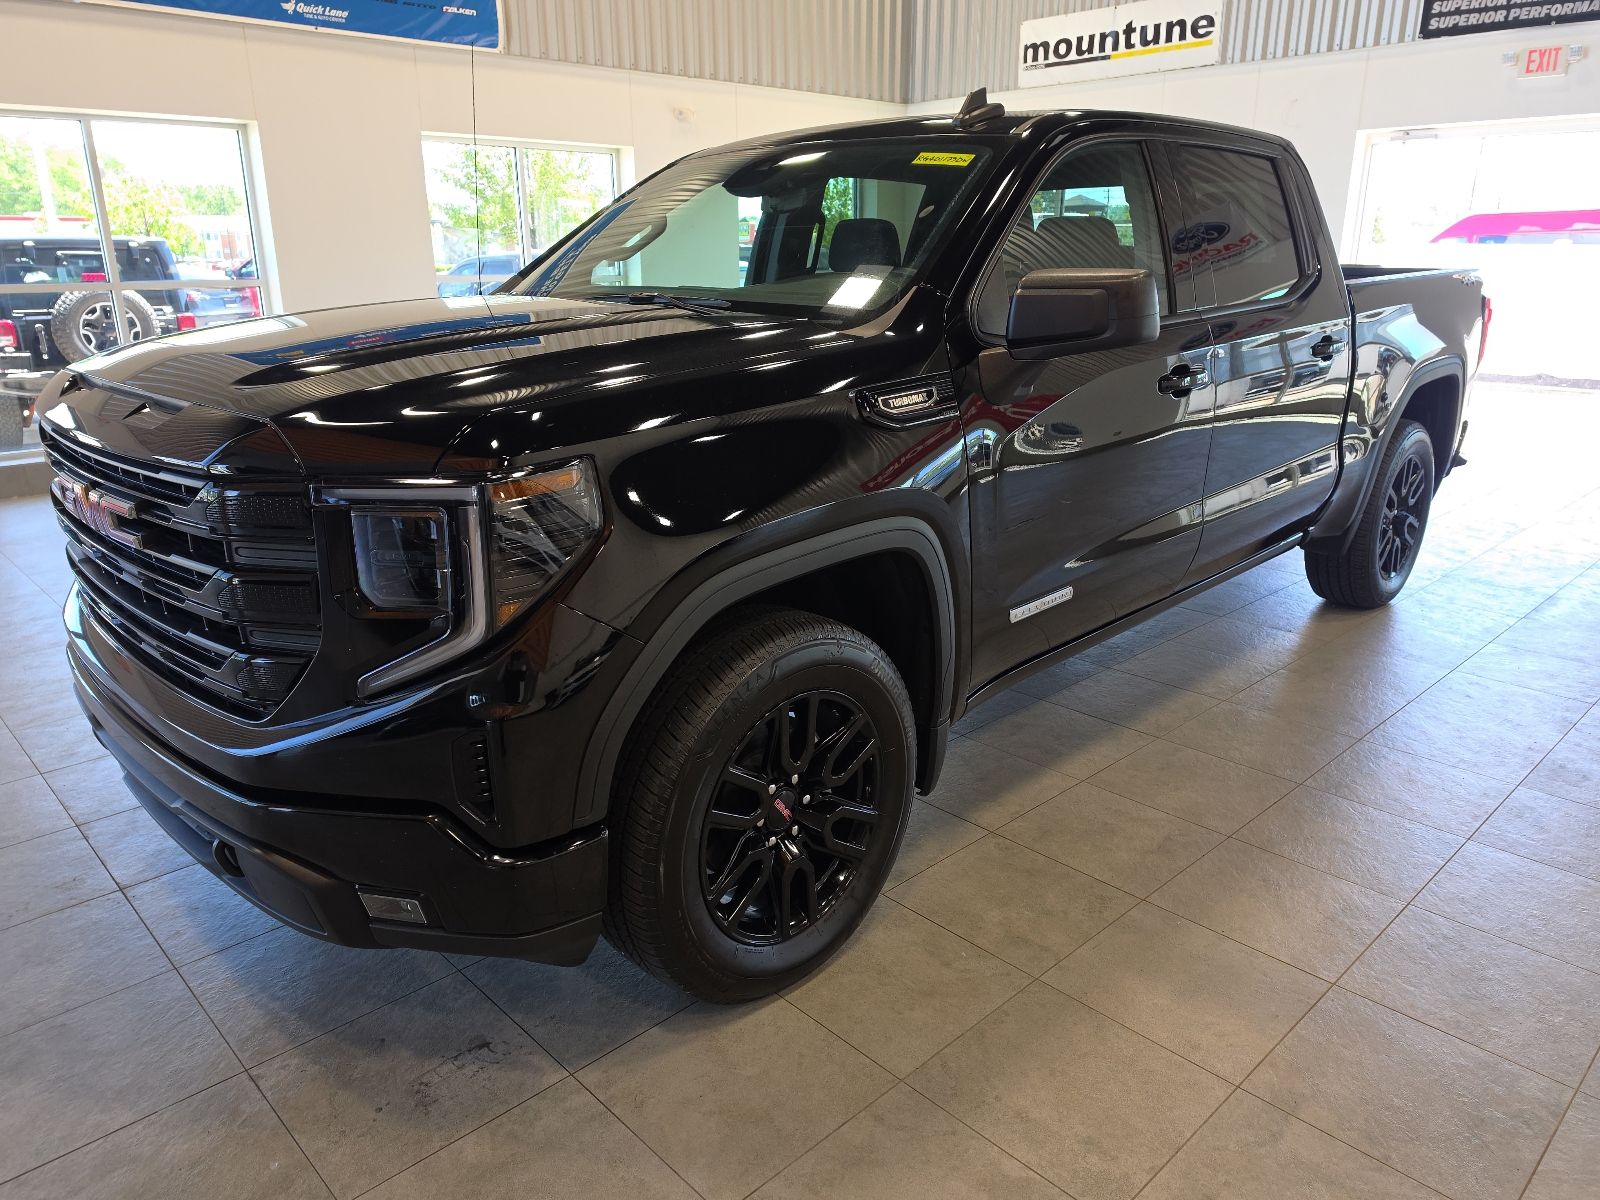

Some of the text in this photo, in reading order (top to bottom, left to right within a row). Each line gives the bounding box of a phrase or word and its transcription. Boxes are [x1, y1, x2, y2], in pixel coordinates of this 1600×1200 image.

[297, 3, 349, 18] Quick Lane
[442, 6, 477, 16] FALKEN
[1428, 1, 1600, 30] SUPERIOR PERFORMA
[1023, 14, 1216, 64] mountune
[1525, 47, 1562, 74] EXIT
[889, 393, 928, 407] TURBOMAX
[50, 472, 143, 549] GMC
[774, 798, 793, 822] GMC
